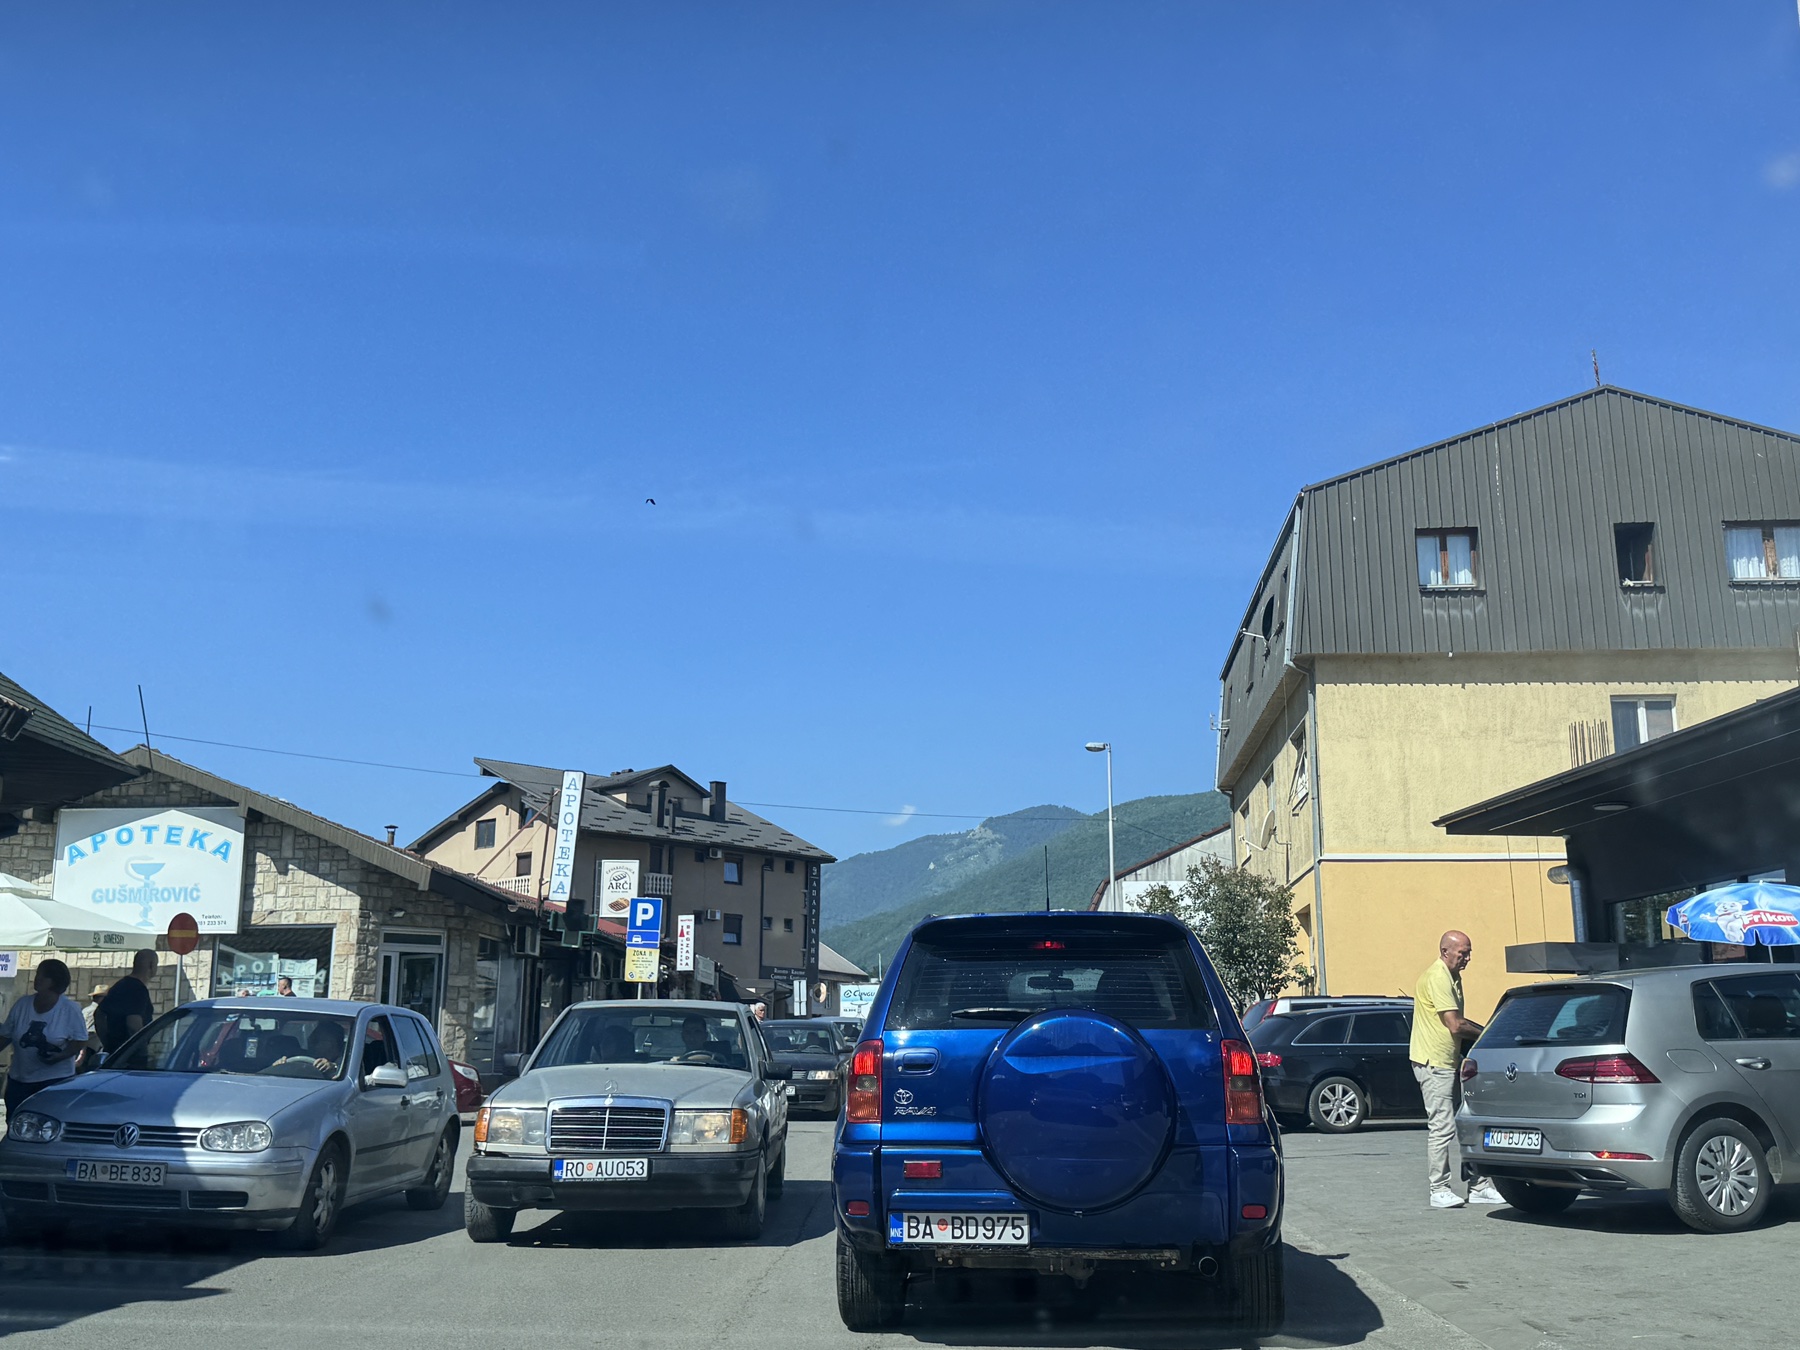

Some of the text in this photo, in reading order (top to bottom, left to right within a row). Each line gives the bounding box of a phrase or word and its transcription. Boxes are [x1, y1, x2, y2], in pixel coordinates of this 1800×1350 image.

[67, 824, 233, 867] APOTEKA
[552, 777, 580, 894] APOTEKA
[91, 882, 201, 904] GUŠMIROVIĆ
[607, 880, 632, 890] ARČI
[635, 902, 654, 926] P
[1742, 911, 1797, 925] Frikom
[893, 1106, 937, 1116] RAV4
[1508, 1131, 1540, 1147] BJ753
[77, 1163, 98, 1180] BA
[109, 1164, 162, 1183] BE833
[565, 1161, 585, 1177] RO
[595, 1160, 645, 1177] AU053
[907, 1215, 934, 1240] BA
[951, 1216, 1025, 1240] BD975
